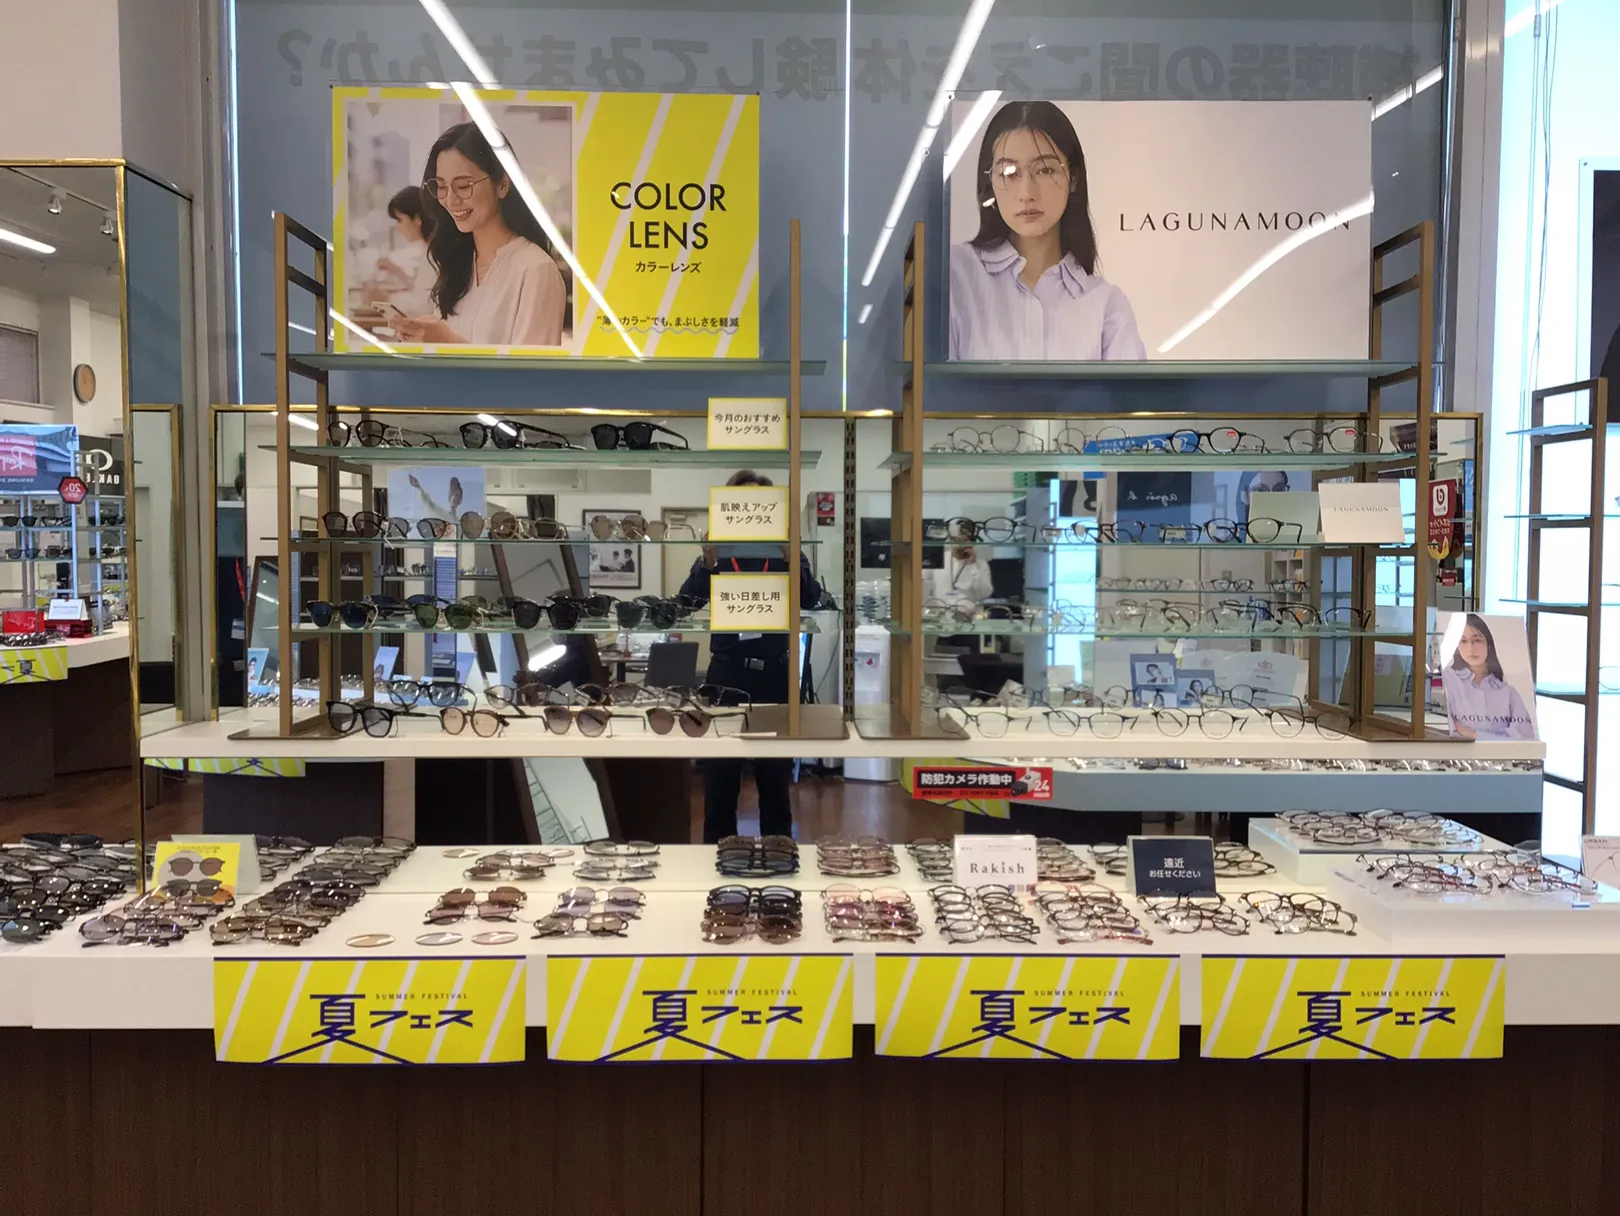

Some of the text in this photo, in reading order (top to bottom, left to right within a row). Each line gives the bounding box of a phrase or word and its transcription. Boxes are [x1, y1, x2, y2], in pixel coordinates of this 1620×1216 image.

[610, 181, 727, 211] COLOR
[629, 221, 709, 250] LENS
[635, 260, 702, 273] カラーレンズ
[715, 413, 781, 423] 今月のおすすめ
[725, 425, 770, 435] サングラス
[720, 501, 778, 512] 肌映えアップ
[726, 515, 772, 525] サングラス
[720, 591, 781, 602] 強い日差し用
[726, 604, 774, 614] サングラス
[920, 773, 1013, 786] 防犯カメラ作動中
[1034, 779, 1050, 792] 24
[970, 861, 1025, 874] Rakish
[1149, 869, 1201, 878] お任せください
[1360, 990, 1451, 998] SUMMER FESTIVAL
[270, 994, 474, 1062] 夏フェス
[600, 990, 803, 1060] 夏フェス
[929, 990, 1131, 1057] 夏フェス
[1257, 991, 1456, 1057] 夏フェス
